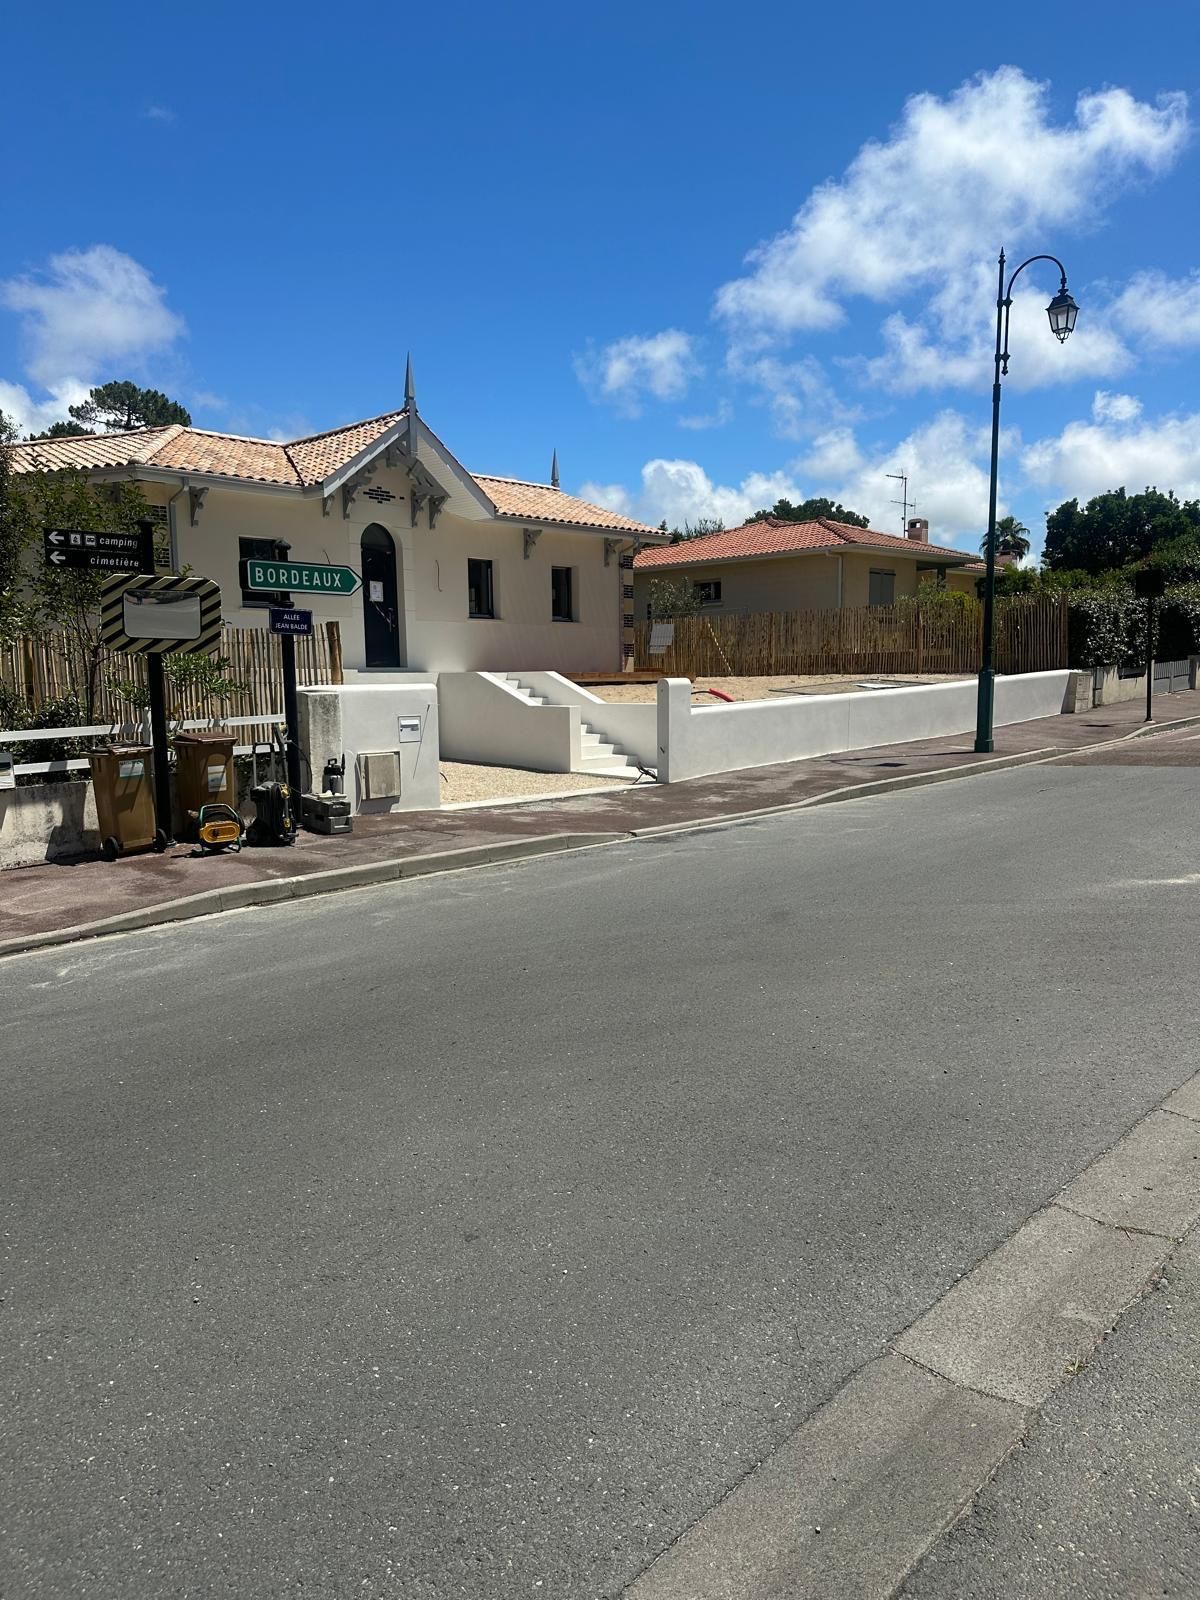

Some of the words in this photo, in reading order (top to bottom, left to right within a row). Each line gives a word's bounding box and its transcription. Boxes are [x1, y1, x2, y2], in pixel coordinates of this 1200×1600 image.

[99, 537, 138, 549] camping
[90, 556, 139, 567] cimetière
[255, 567, 342, 588] BORDEAUX
